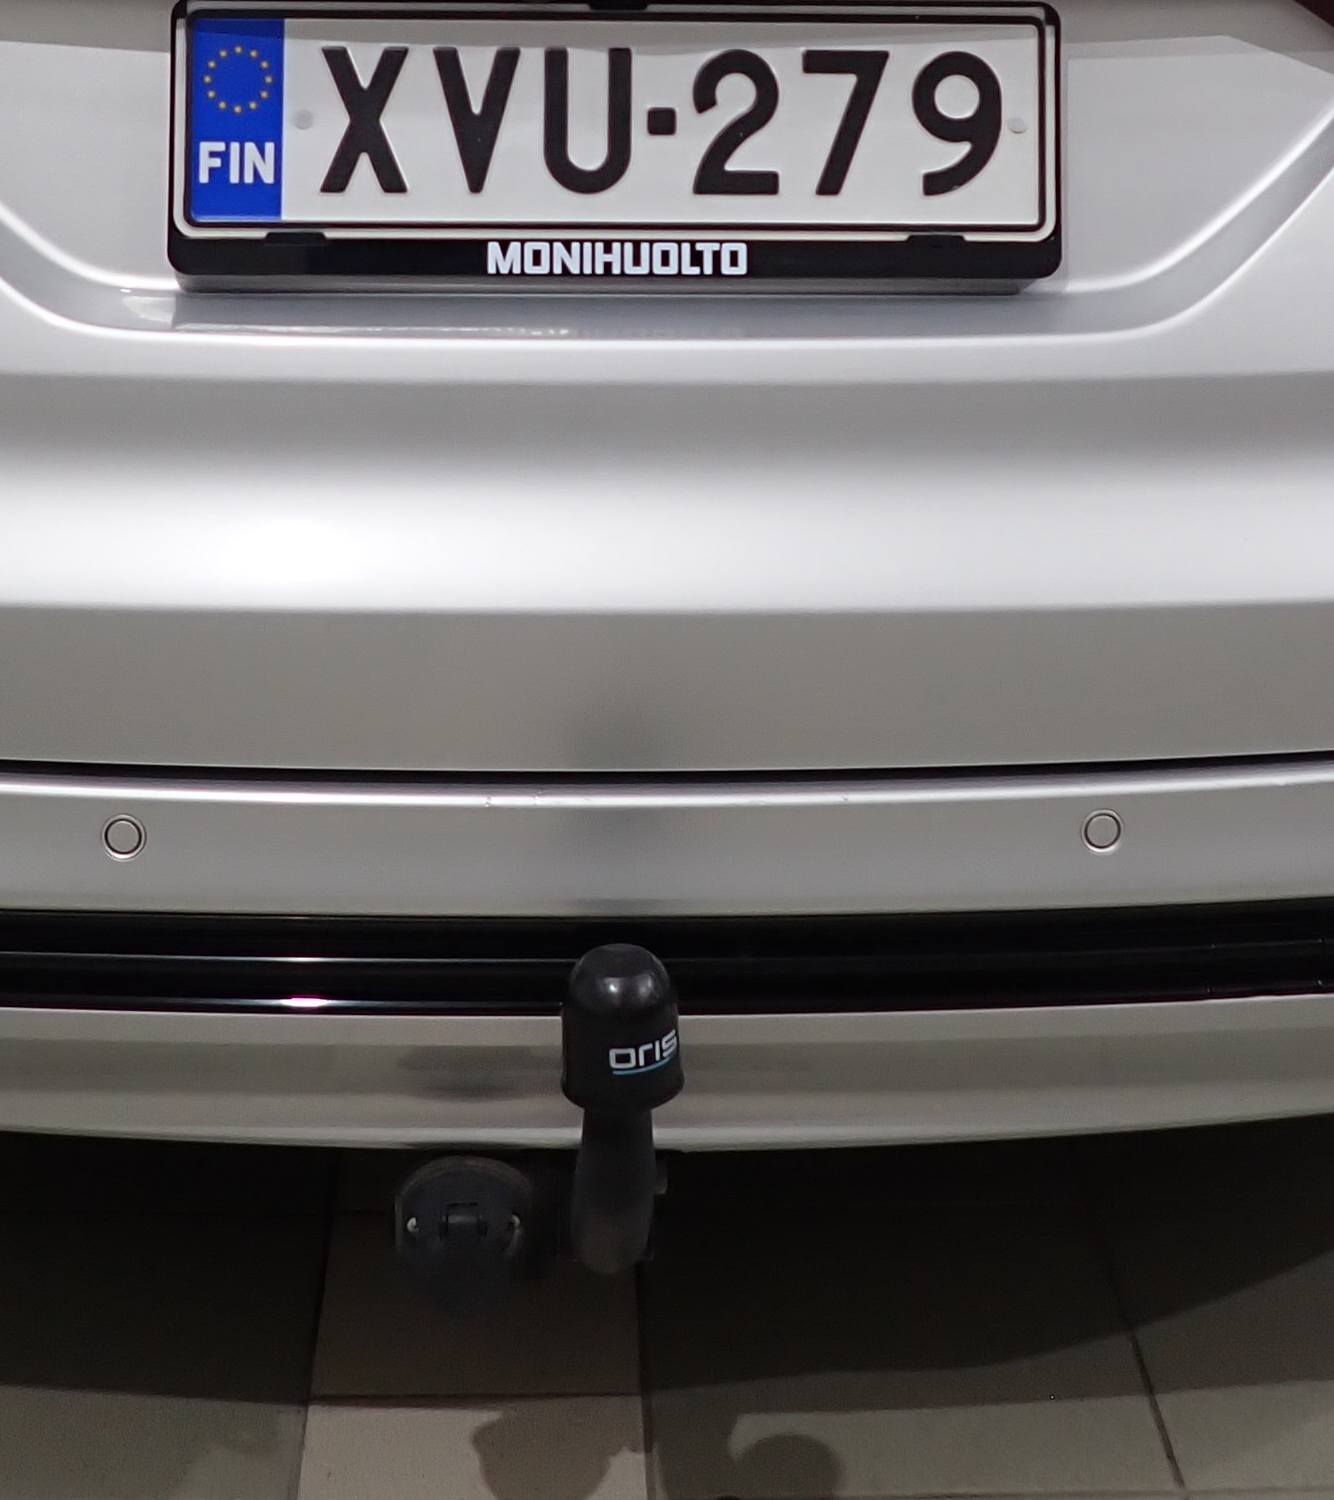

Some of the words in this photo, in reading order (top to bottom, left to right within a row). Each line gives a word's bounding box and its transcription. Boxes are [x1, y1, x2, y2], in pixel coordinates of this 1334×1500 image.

[320, 46, 1003, 197] XVU-279
[199, 141, 274, 184] FIN
[487, 242, 748, 277] MONIHUOLTO
